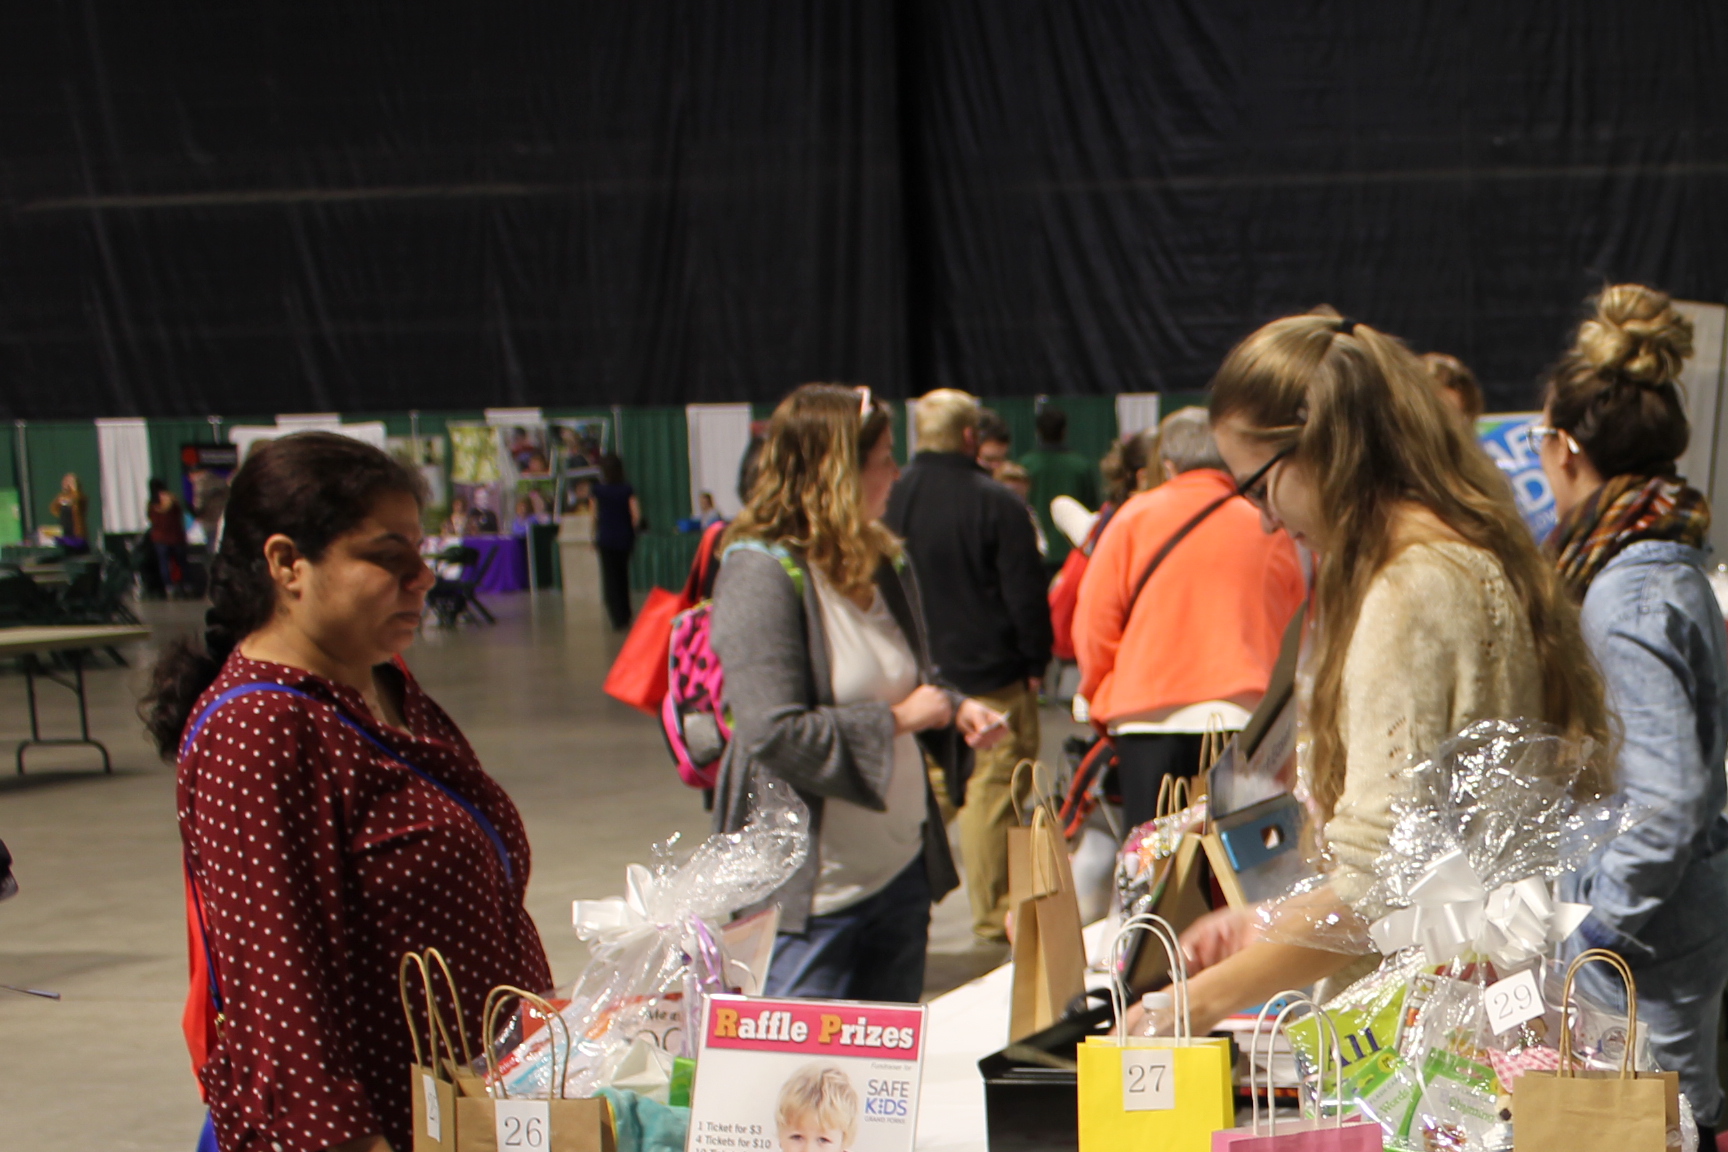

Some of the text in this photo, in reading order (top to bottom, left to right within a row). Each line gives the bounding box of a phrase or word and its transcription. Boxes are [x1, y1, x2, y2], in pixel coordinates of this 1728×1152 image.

[1494, 983, 1532, 1020] 29
[714, 1008, 915, 1050] Raffle Prizes
[867, 1078, 910, 1098] SAFE
[1128, 1064, 1167, 1093] 27
[504, 1116, 543, 1148] 26
[705, 1134, 735, 1147] Tickets
[738, 1137, 750, 1148] for
[752, 1138, 772, 1150] $10
[706, 1121, 732, 1134] Ticket
[735, 1124, 748, 1134] for
[750, 1124, 763, 1136] $3
